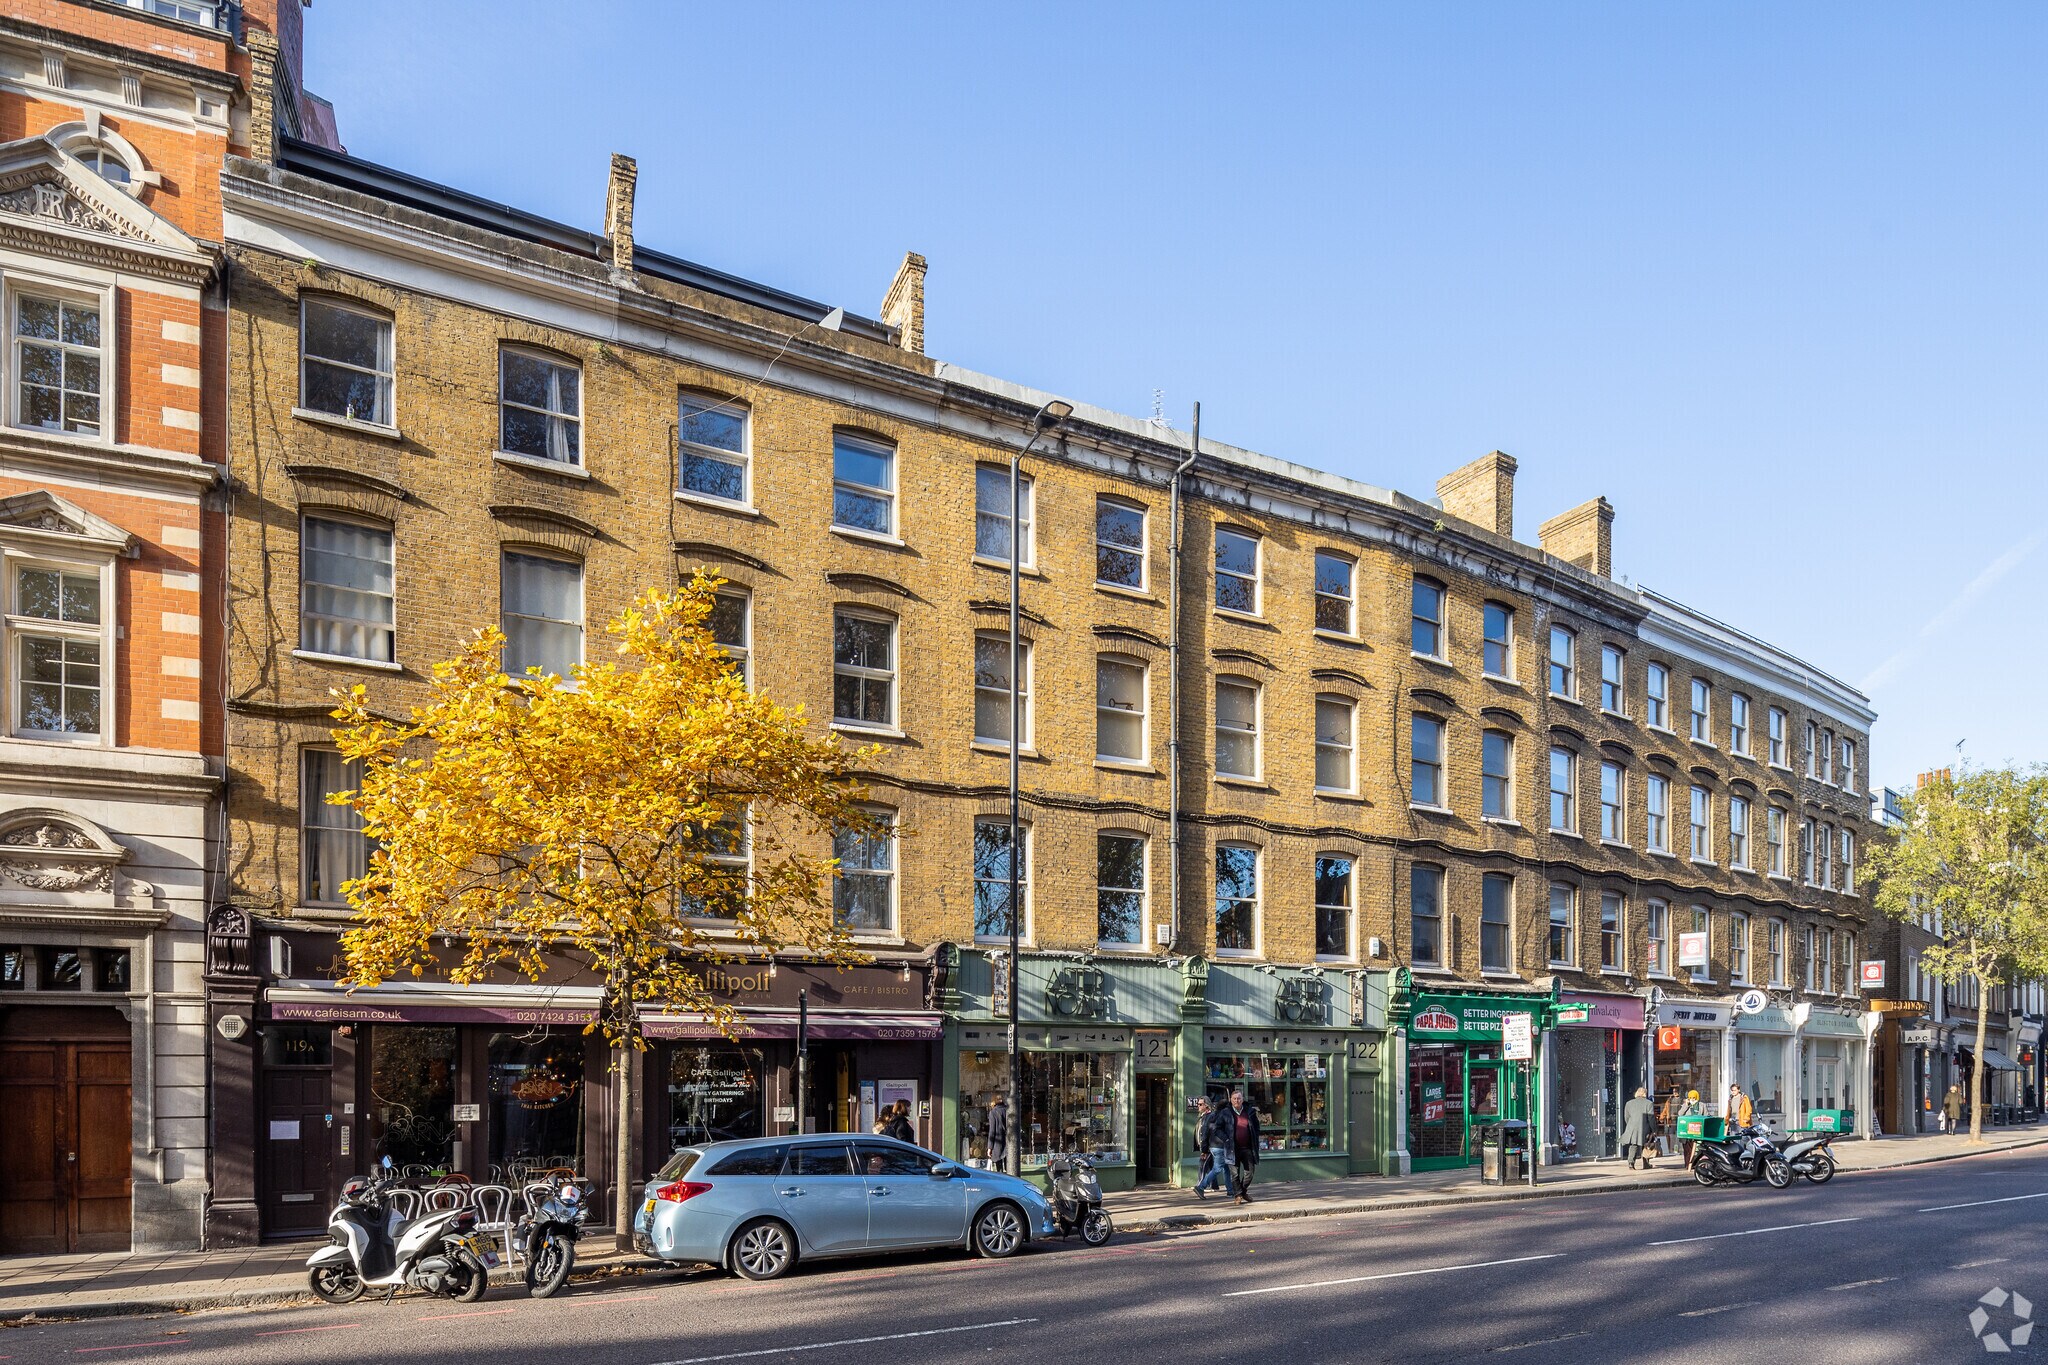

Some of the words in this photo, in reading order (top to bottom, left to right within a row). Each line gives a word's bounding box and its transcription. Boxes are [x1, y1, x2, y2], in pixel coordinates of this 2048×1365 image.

[843, 985, 868, 994] CAFE
[877, 986, 909, 995] BISTRO
[282, 1007, 401, 1019] www.cafeisarn.co.uk
[517, 1011, 537, 1021] 020
[540, 1012, 564, 1022] 7424
[1463, 1008, 1489, 1018] BETTER
[1490, 1009, 1532, 1018] INGREDI
[1416, 1015, 1434, 1029] PAPA
[1434, 1014, 1457, 1029] JOHNS
[1463, 1021, 1489, 1031] BETTER
[650, 1024, 756, 1038] www.gallipolica.co.uk
[877, 1028, 893, 1038] 020
[895, 1029, 915, 1038] 7359
[918, 1030, 937, 1038] 1578
[1137, 1039, 1171, 1058] 121
[1350, 1042, 1378, 1059] 122
[691, 1068, 712, 1077] CAFE
[1425, 1087, 1442, 1097] LARGE
